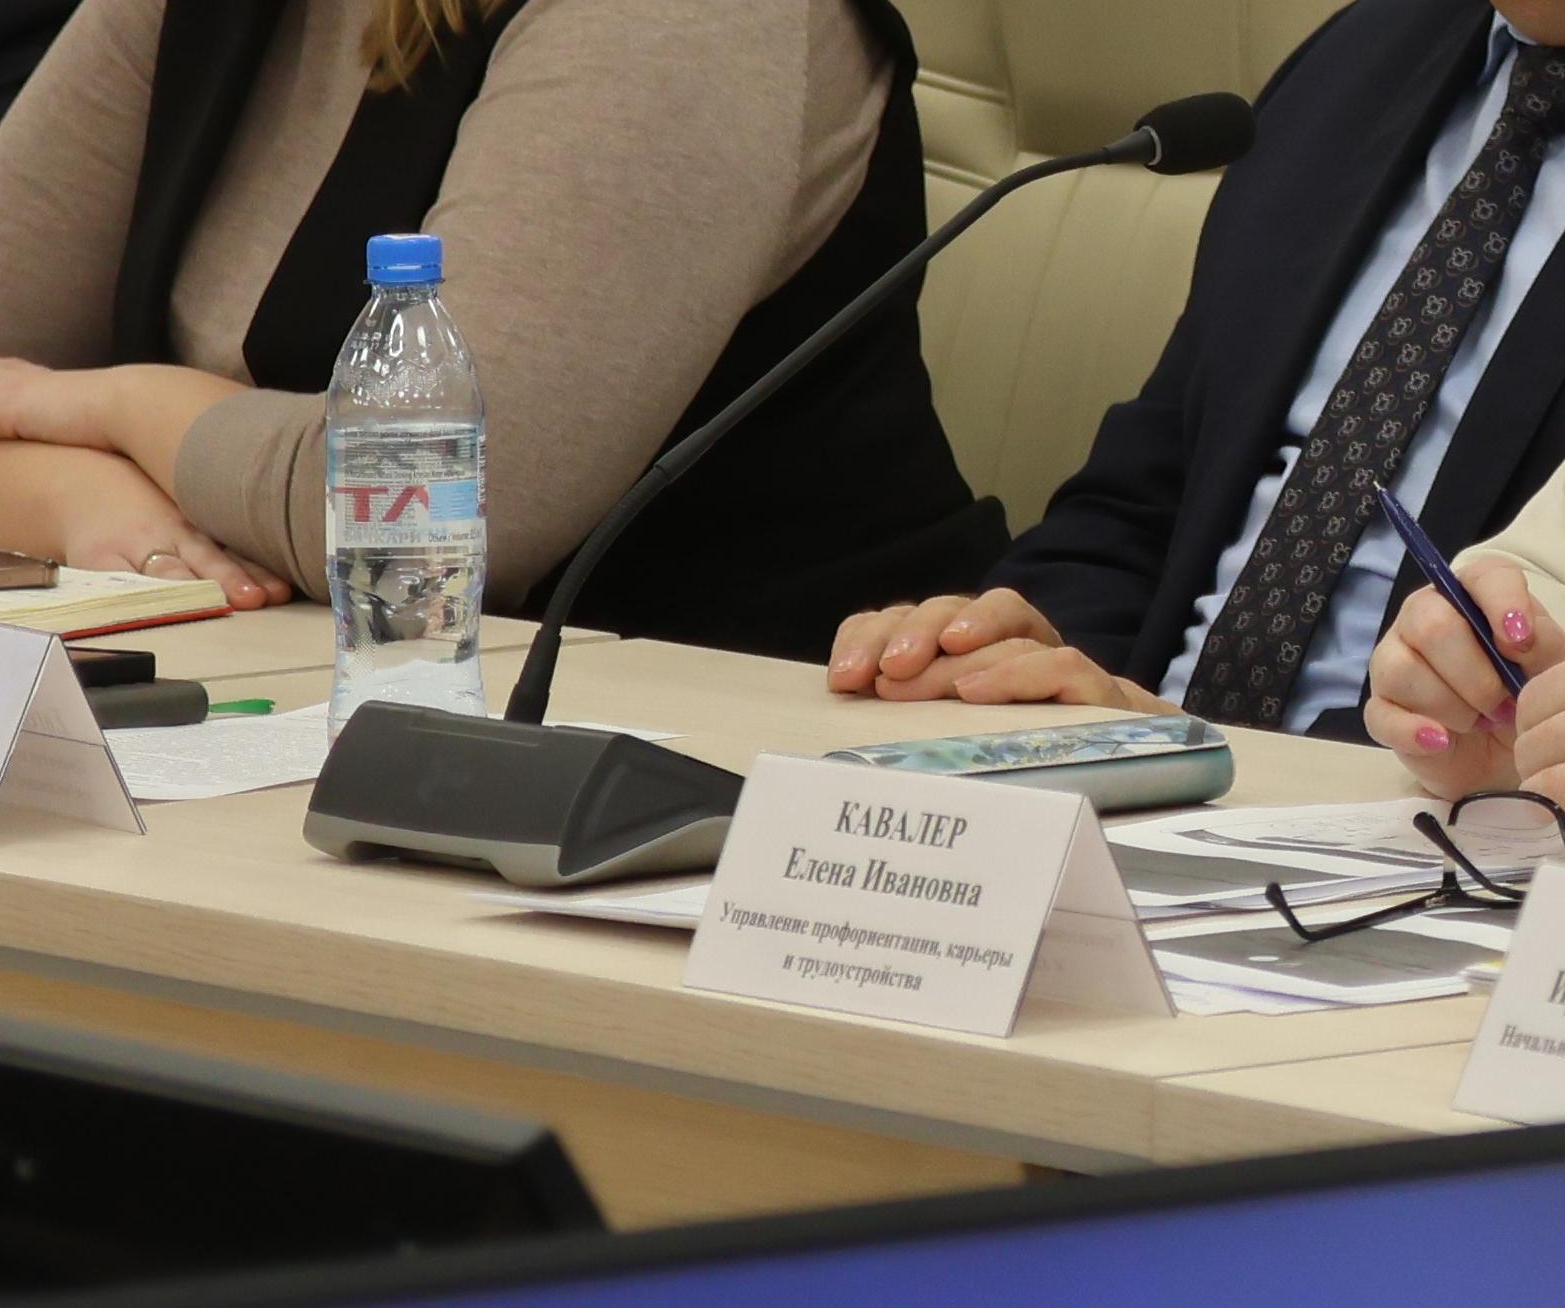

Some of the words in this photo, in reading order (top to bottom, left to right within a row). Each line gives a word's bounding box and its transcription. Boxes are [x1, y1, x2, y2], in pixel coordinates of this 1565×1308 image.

[834, 800, 968, 850] КАВАЛЕР
[783, 846, 857, 888] Елена
[860, 859, 983, 907] Ивановна
[719, 901, 810, 936] Управление
[810, 920, 942, 959] профориентации,
[945, 941, 1014, 972] карьеры
[782, 953, 793, 971] и
[797, 955, 923, 991] трудоустройства
